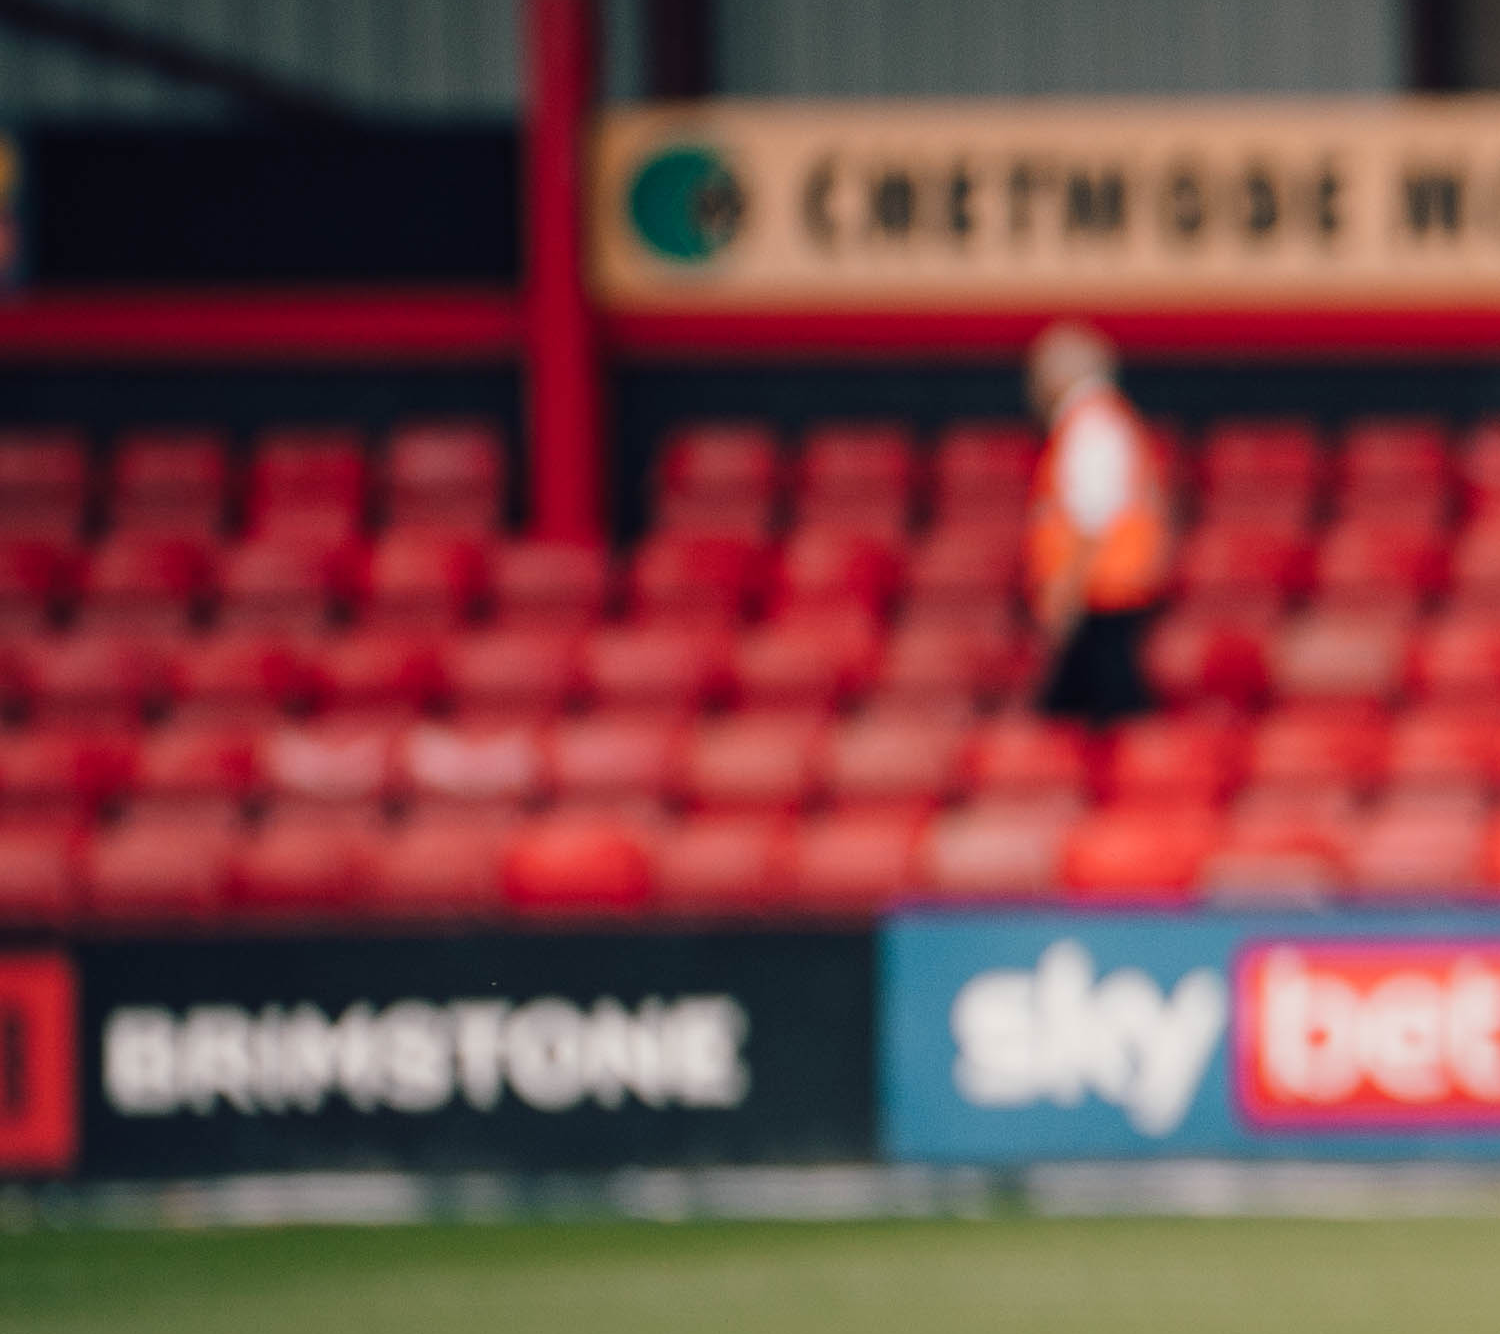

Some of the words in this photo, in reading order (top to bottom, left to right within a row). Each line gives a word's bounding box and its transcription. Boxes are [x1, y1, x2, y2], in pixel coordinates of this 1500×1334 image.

[792, 149, 1358, 257] CHETWODE
[103, 995, 750, 1116] BRIMSTONE
[951, 936, 1228, 1139] sky
